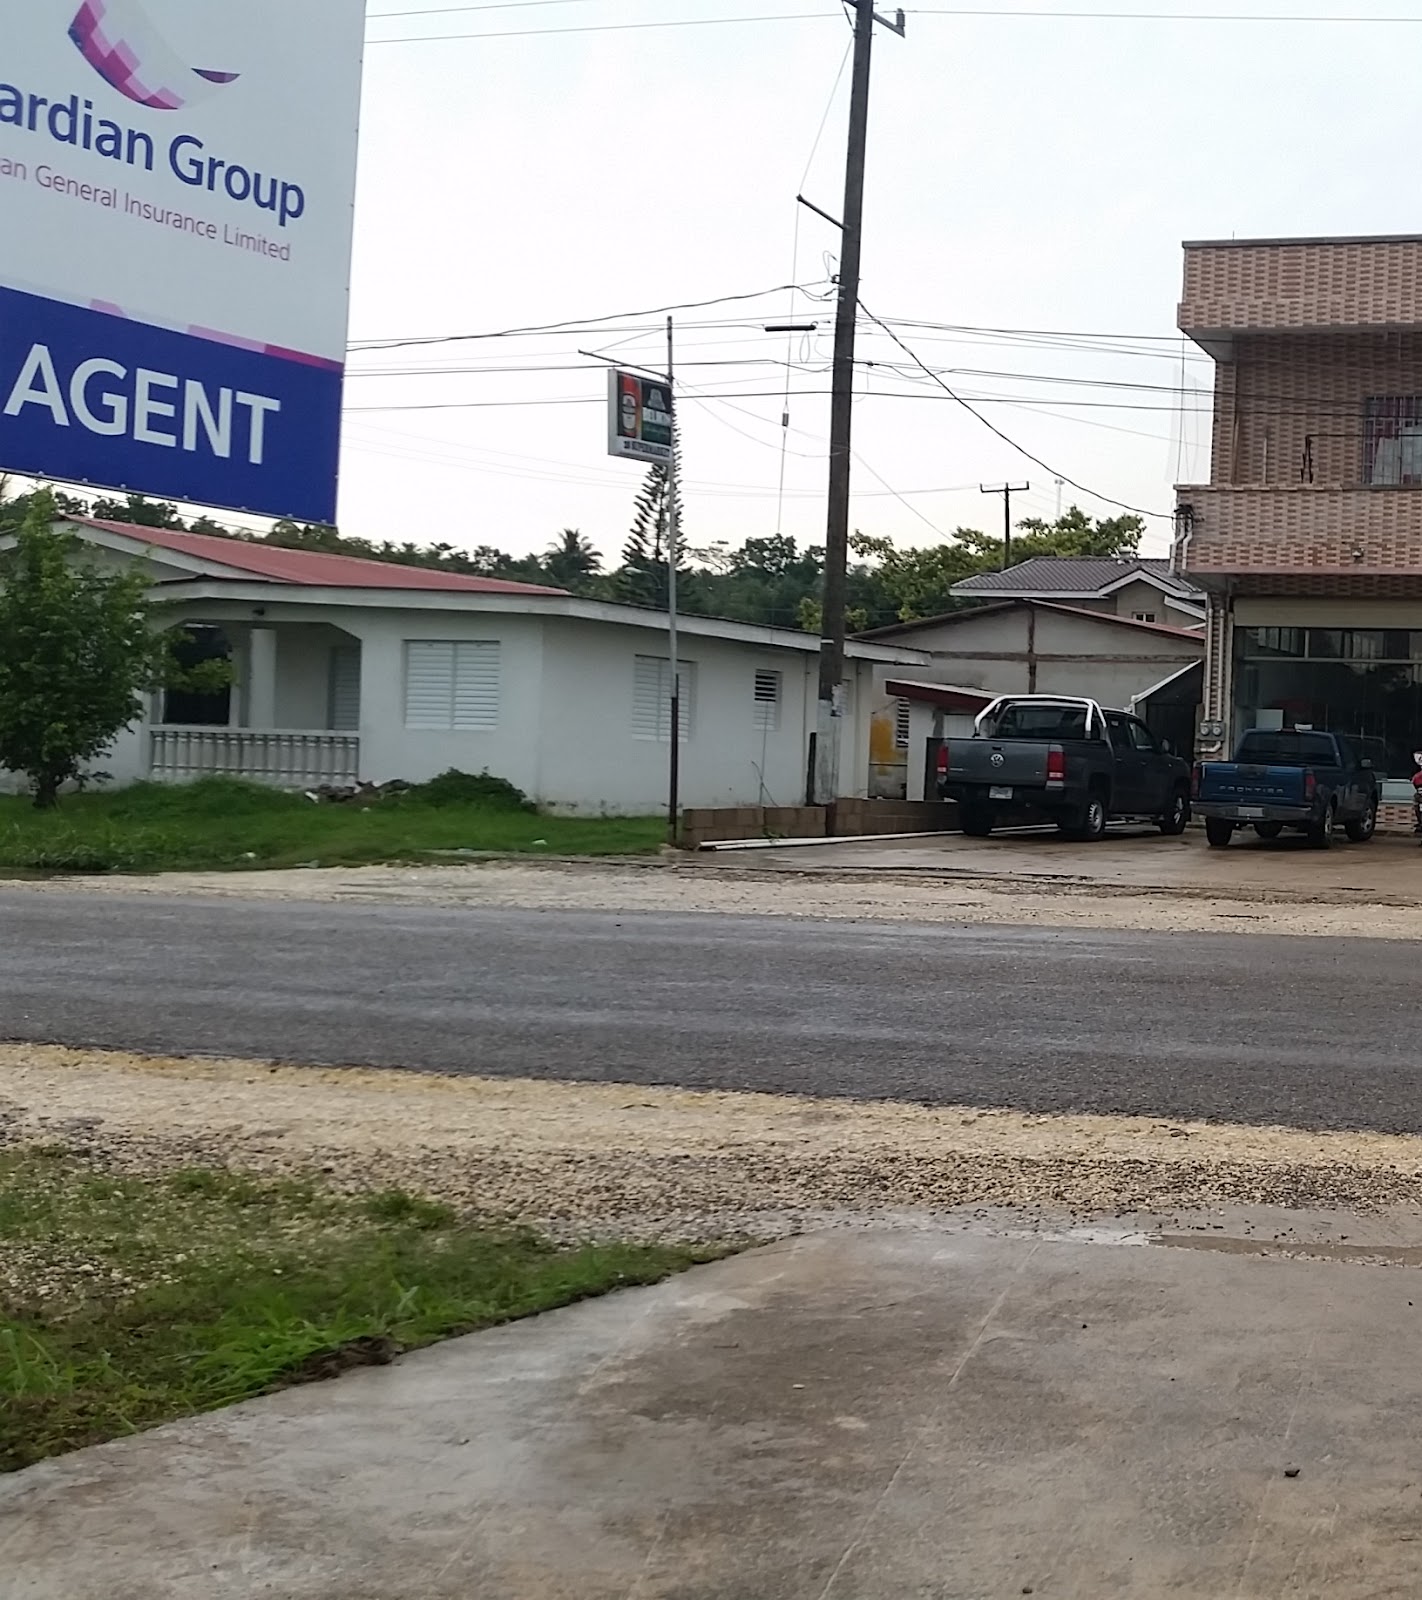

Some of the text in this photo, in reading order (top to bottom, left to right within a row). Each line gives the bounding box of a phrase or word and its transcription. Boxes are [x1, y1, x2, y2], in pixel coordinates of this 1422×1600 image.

[35, 165, 117, 209] General
[124, 192, 217, 239] Insurance
[223, 224, 291, 262] Limited
[169, 134, 305, 227] Group
[4, 343, 281, 465] AGENT
